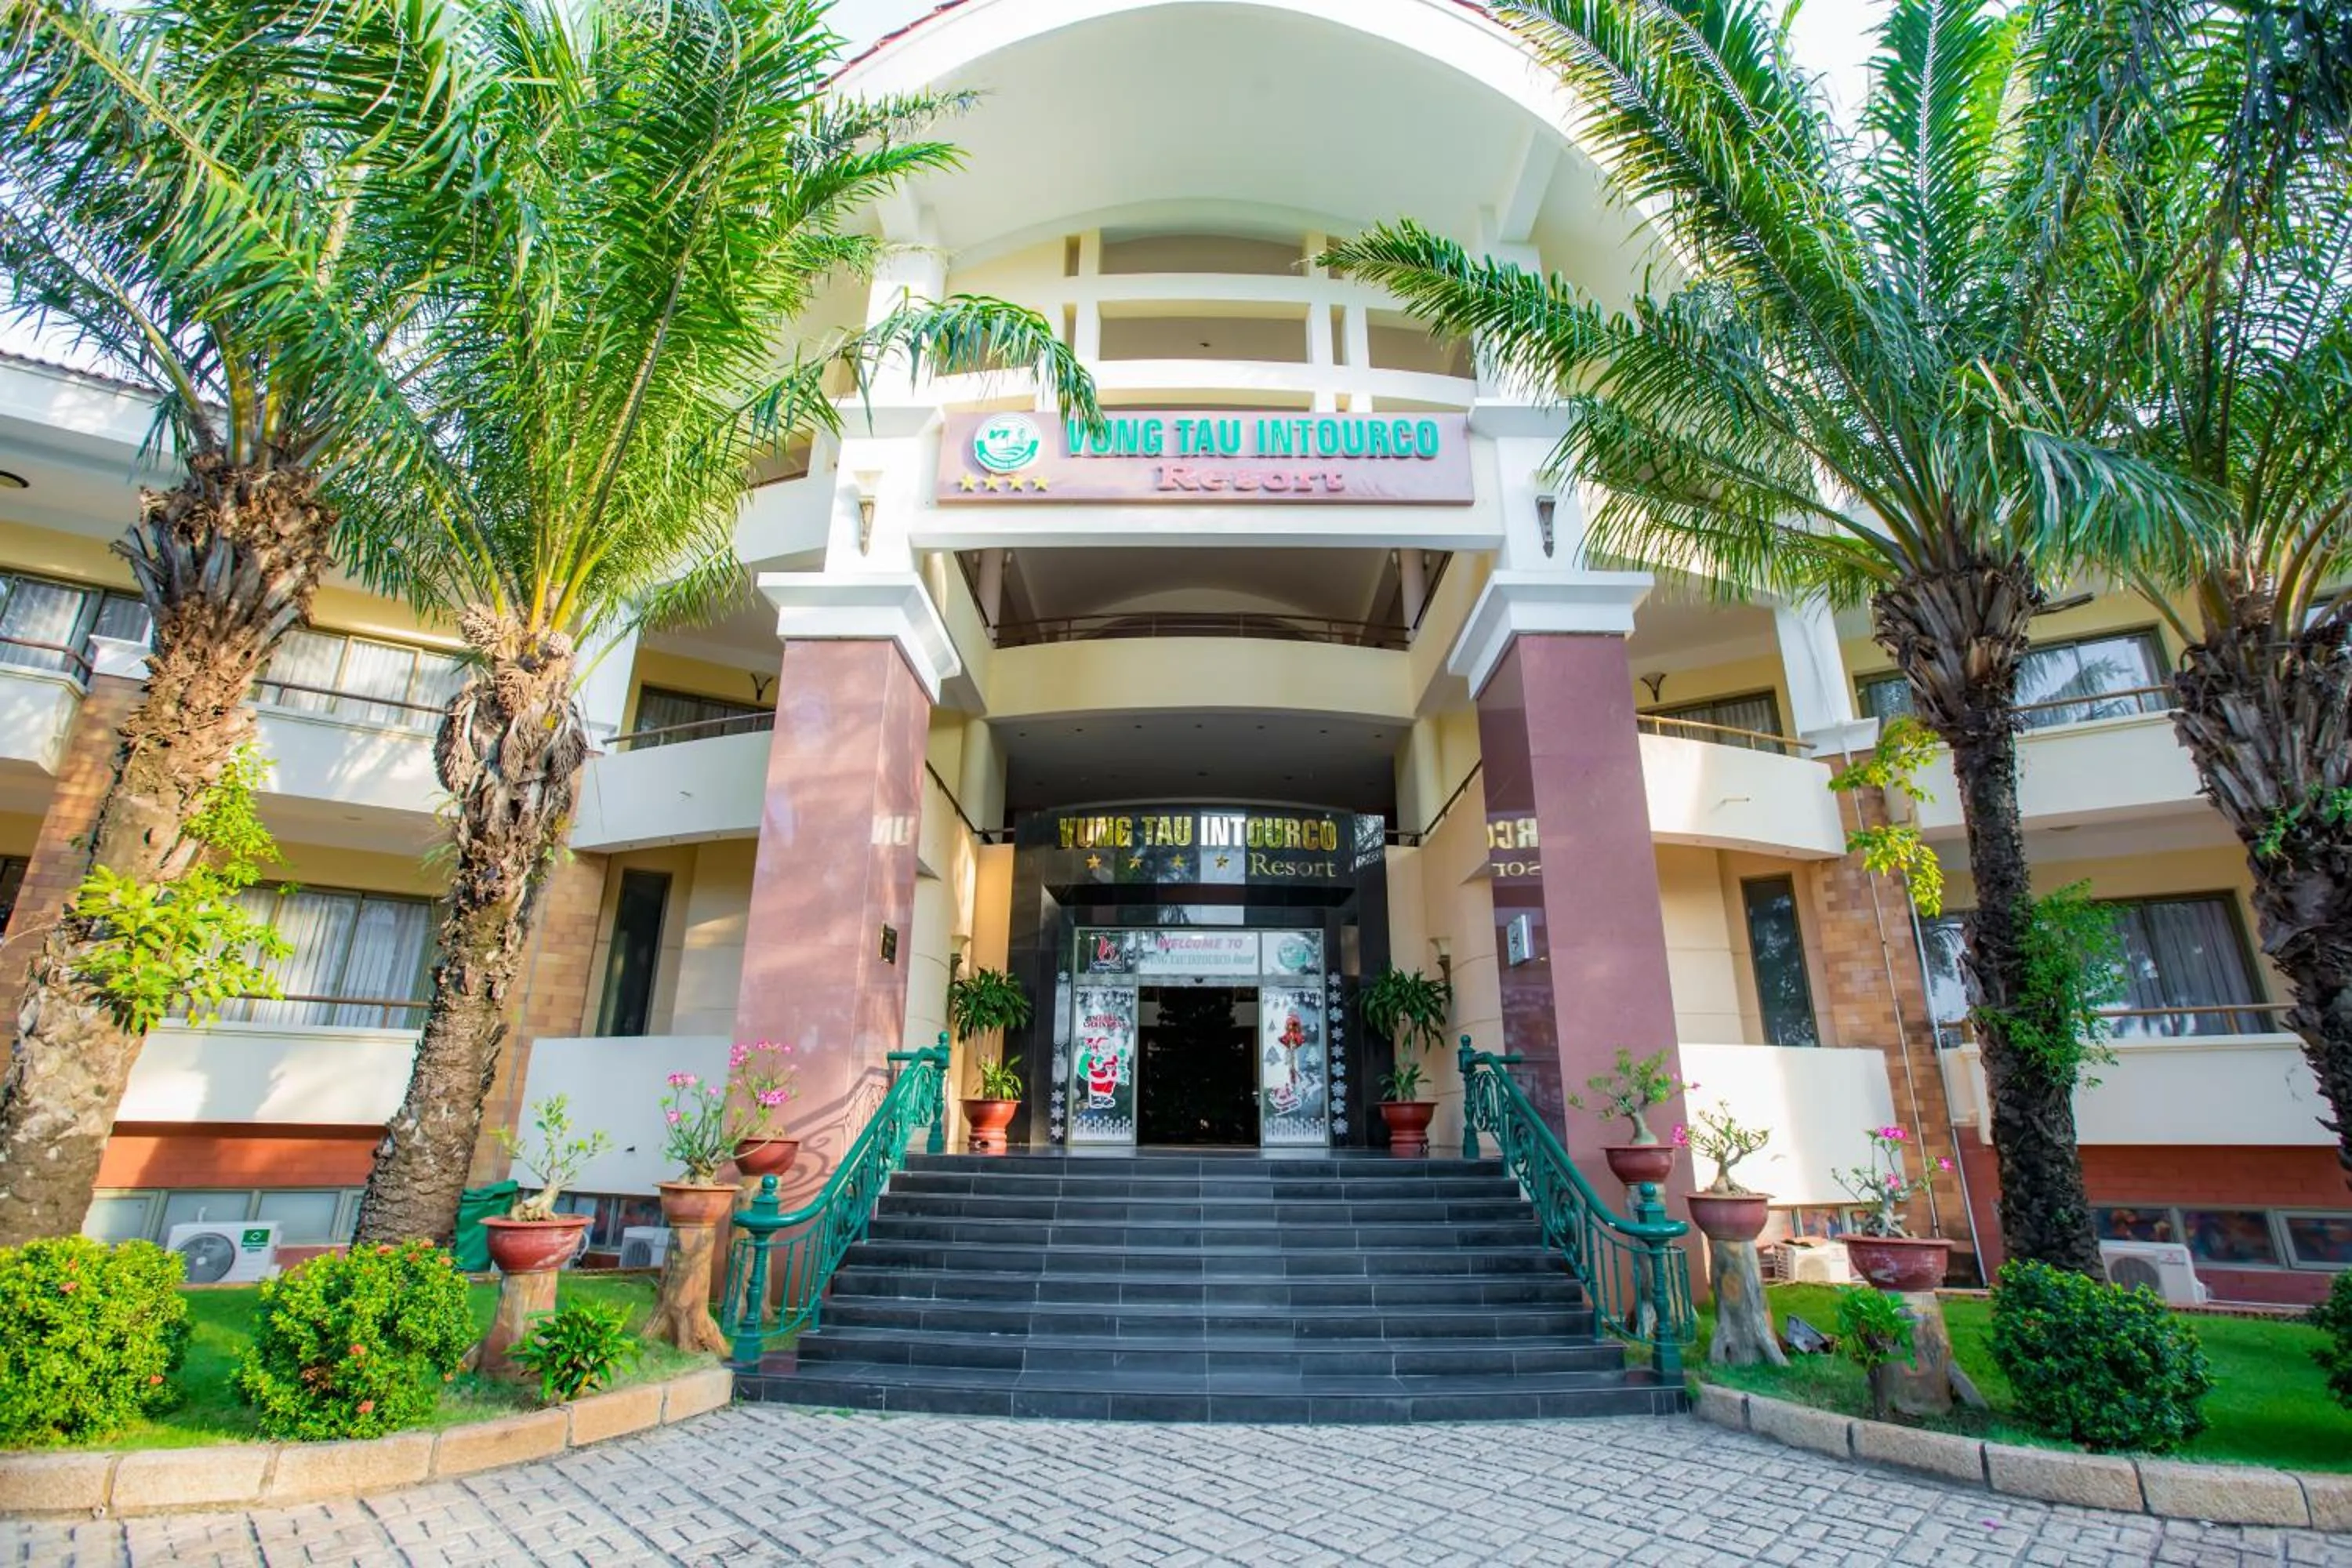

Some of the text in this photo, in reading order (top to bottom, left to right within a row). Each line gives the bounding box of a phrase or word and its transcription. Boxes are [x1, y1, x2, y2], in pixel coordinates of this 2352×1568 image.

[1067, 418, 1439, 457] VUNG TAU INTOURCO
[1157, 464, 1345, 492] Resort
[1058, 815, 1337, 851] VUNG TAU INTOURCO
[1248, 851, 1337, 878] Resort
[1228, 938, 1243, 949] TO
